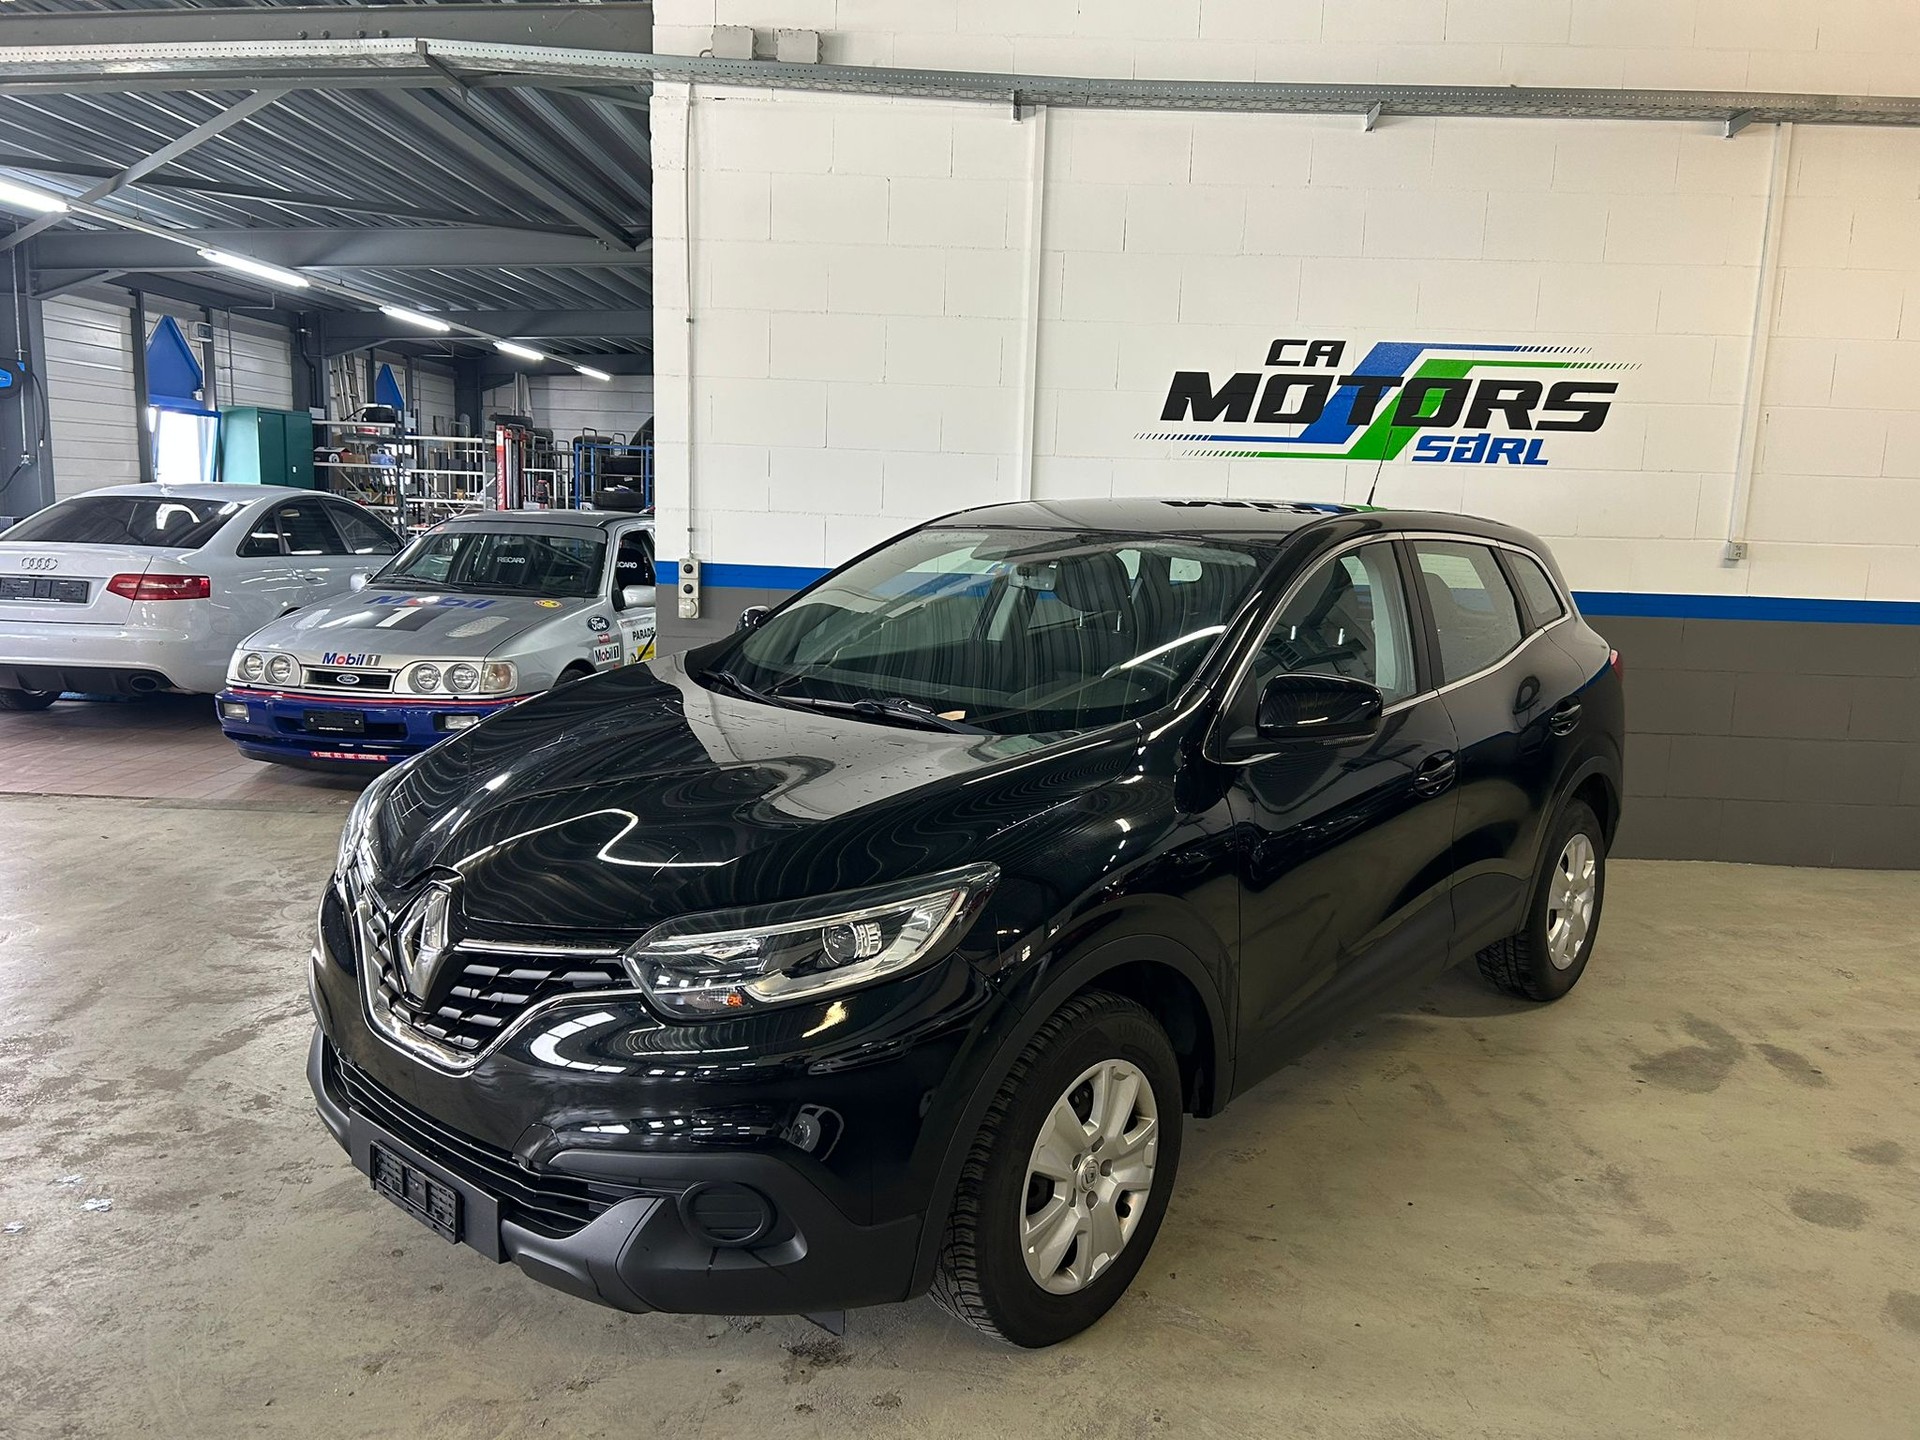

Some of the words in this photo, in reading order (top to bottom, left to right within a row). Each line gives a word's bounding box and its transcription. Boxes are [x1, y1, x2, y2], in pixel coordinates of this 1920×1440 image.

[1265, 339, 1346, 367] CA
[1160, 371, 1619, 432] MOTORS
[496, 556, 525, 564] RECARO
[375, 606, 423, 628] 1
[322, 652, 366, 666] Mobil
[594, 646, 613, 662] Mobil
